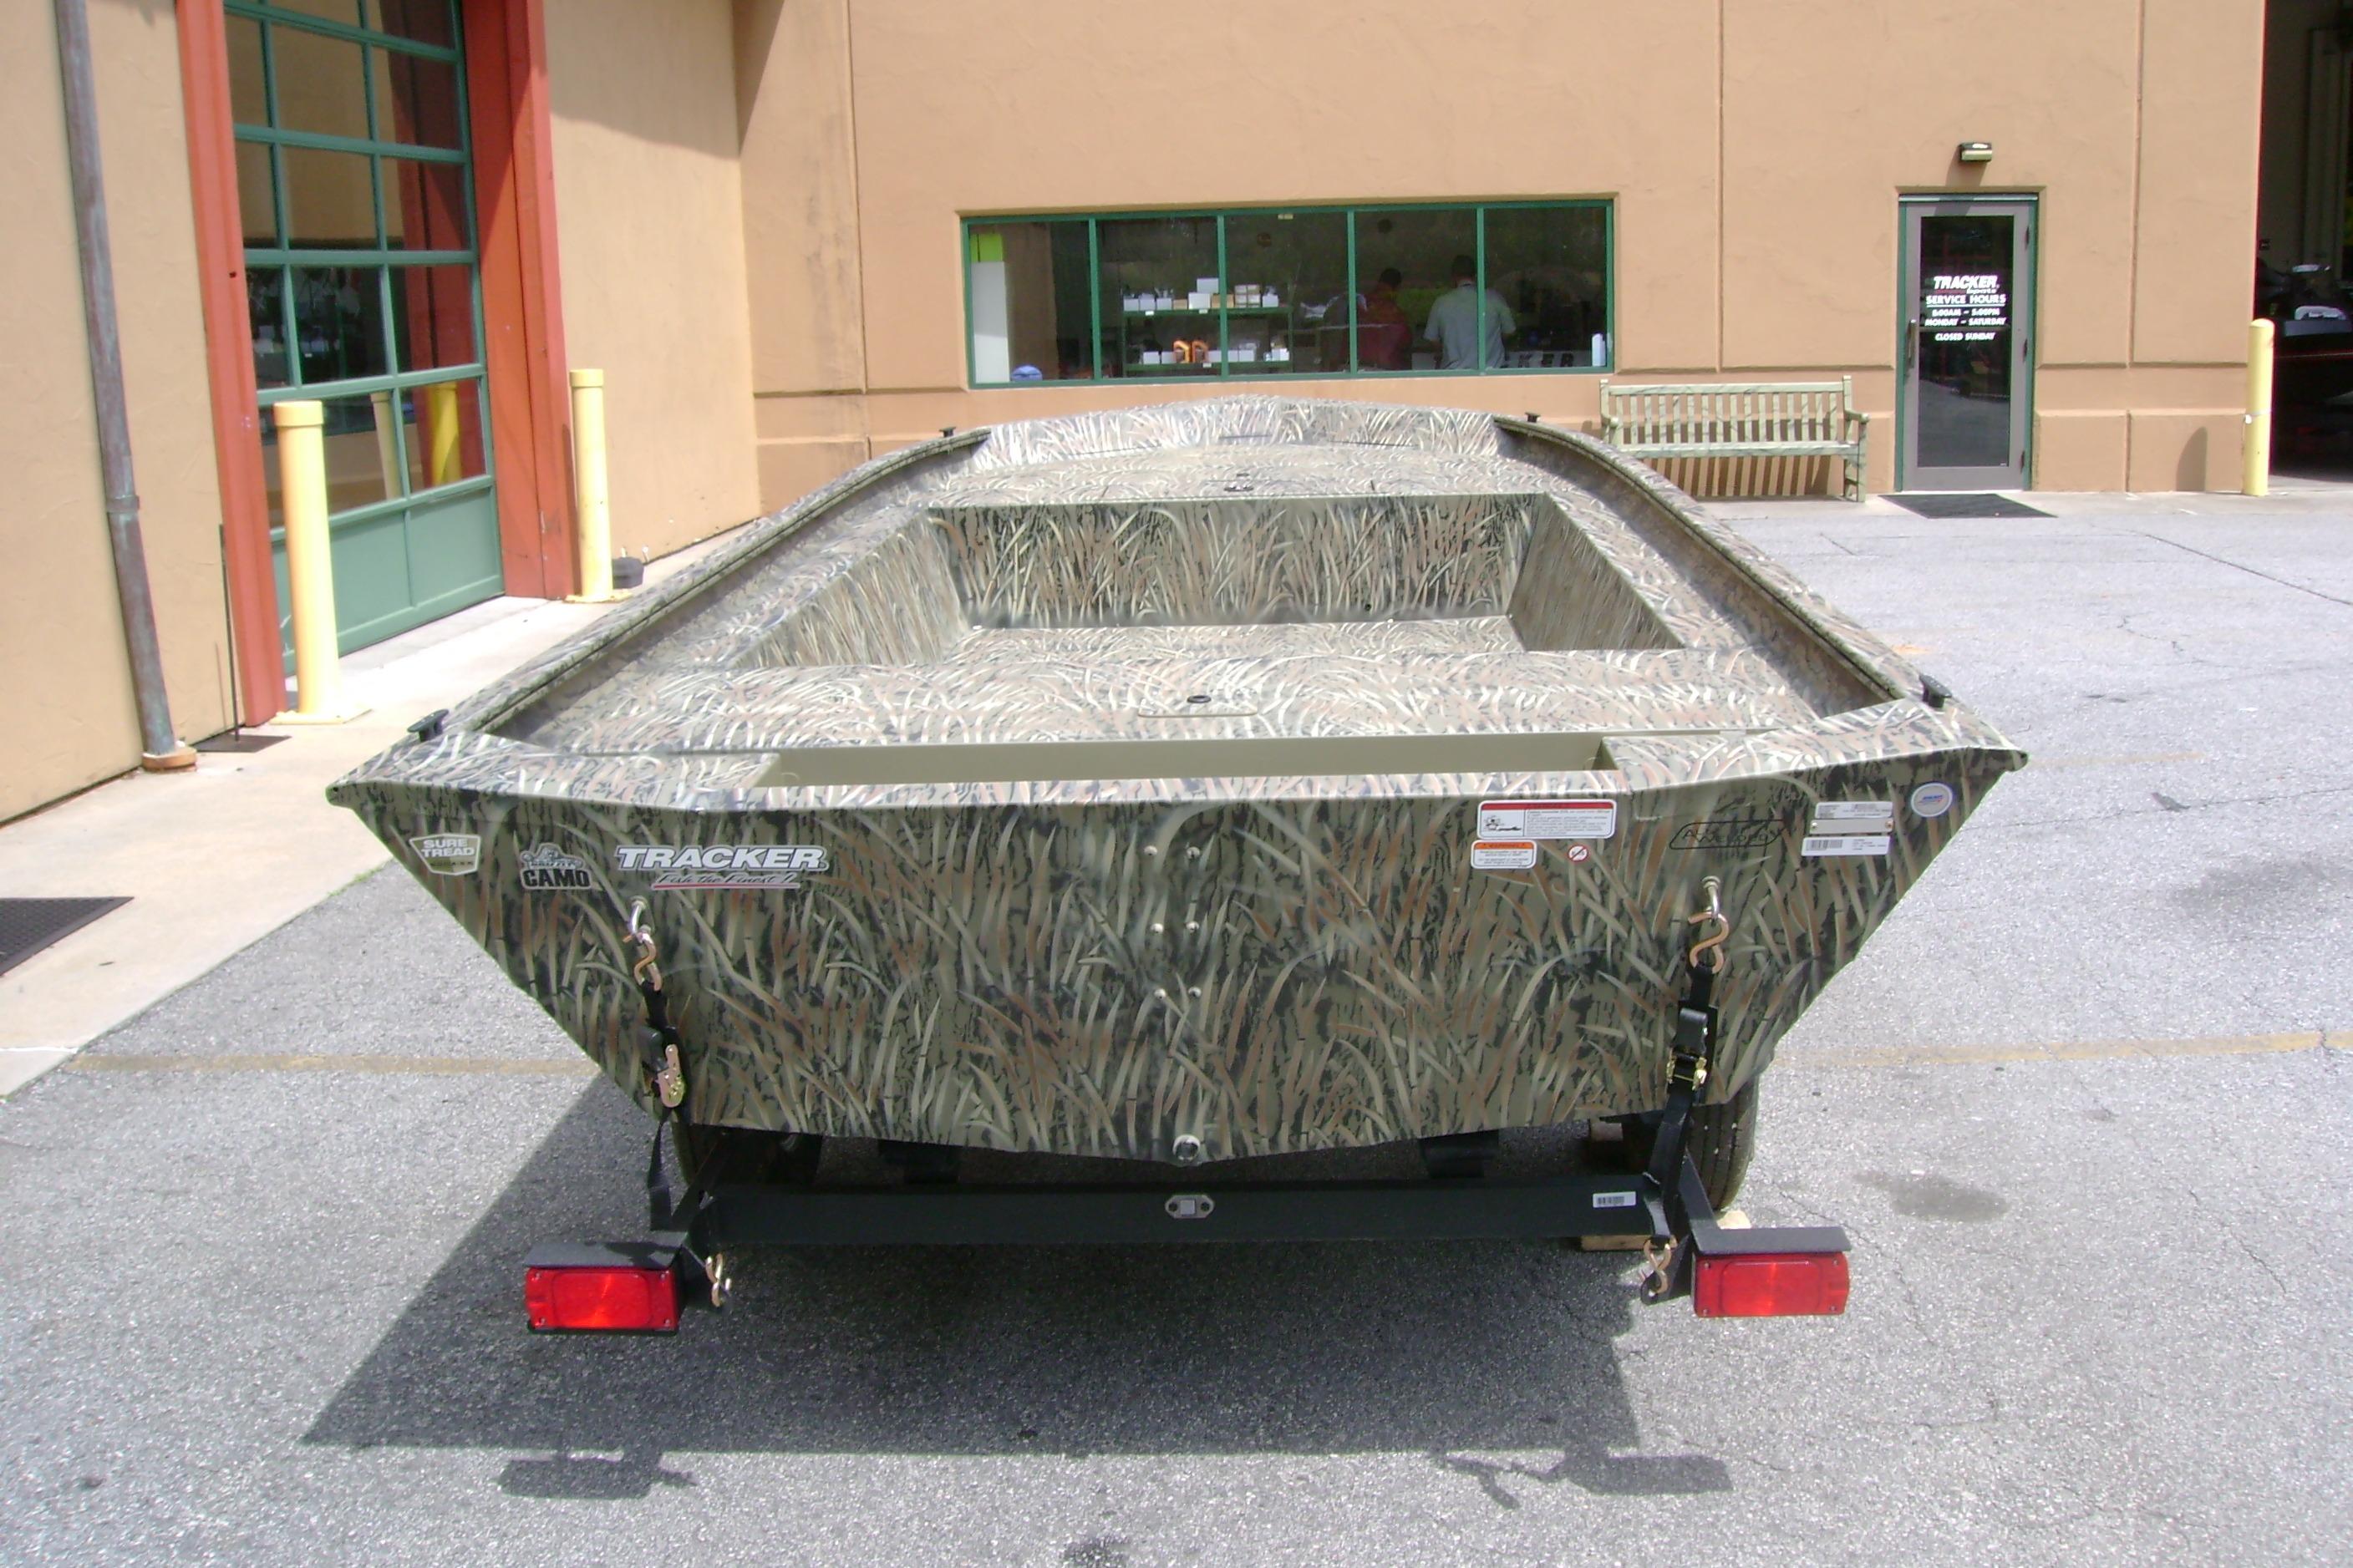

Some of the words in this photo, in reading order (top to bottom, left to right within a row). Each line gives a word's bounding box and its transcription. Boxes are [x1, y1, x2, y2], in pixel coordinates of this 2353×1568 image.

[1934, 276, 2000, 289] TRACKER
[1926, 295, 1965, 304] SERVICE
[1969, 294, 2005, 304] HOURS
[424, 838, 468, 849] SURE
[421, 847, 475, 857] TREAD
[617, 848, 827, 869] TRACKER
[523, 869, 591, 887] CAMO
